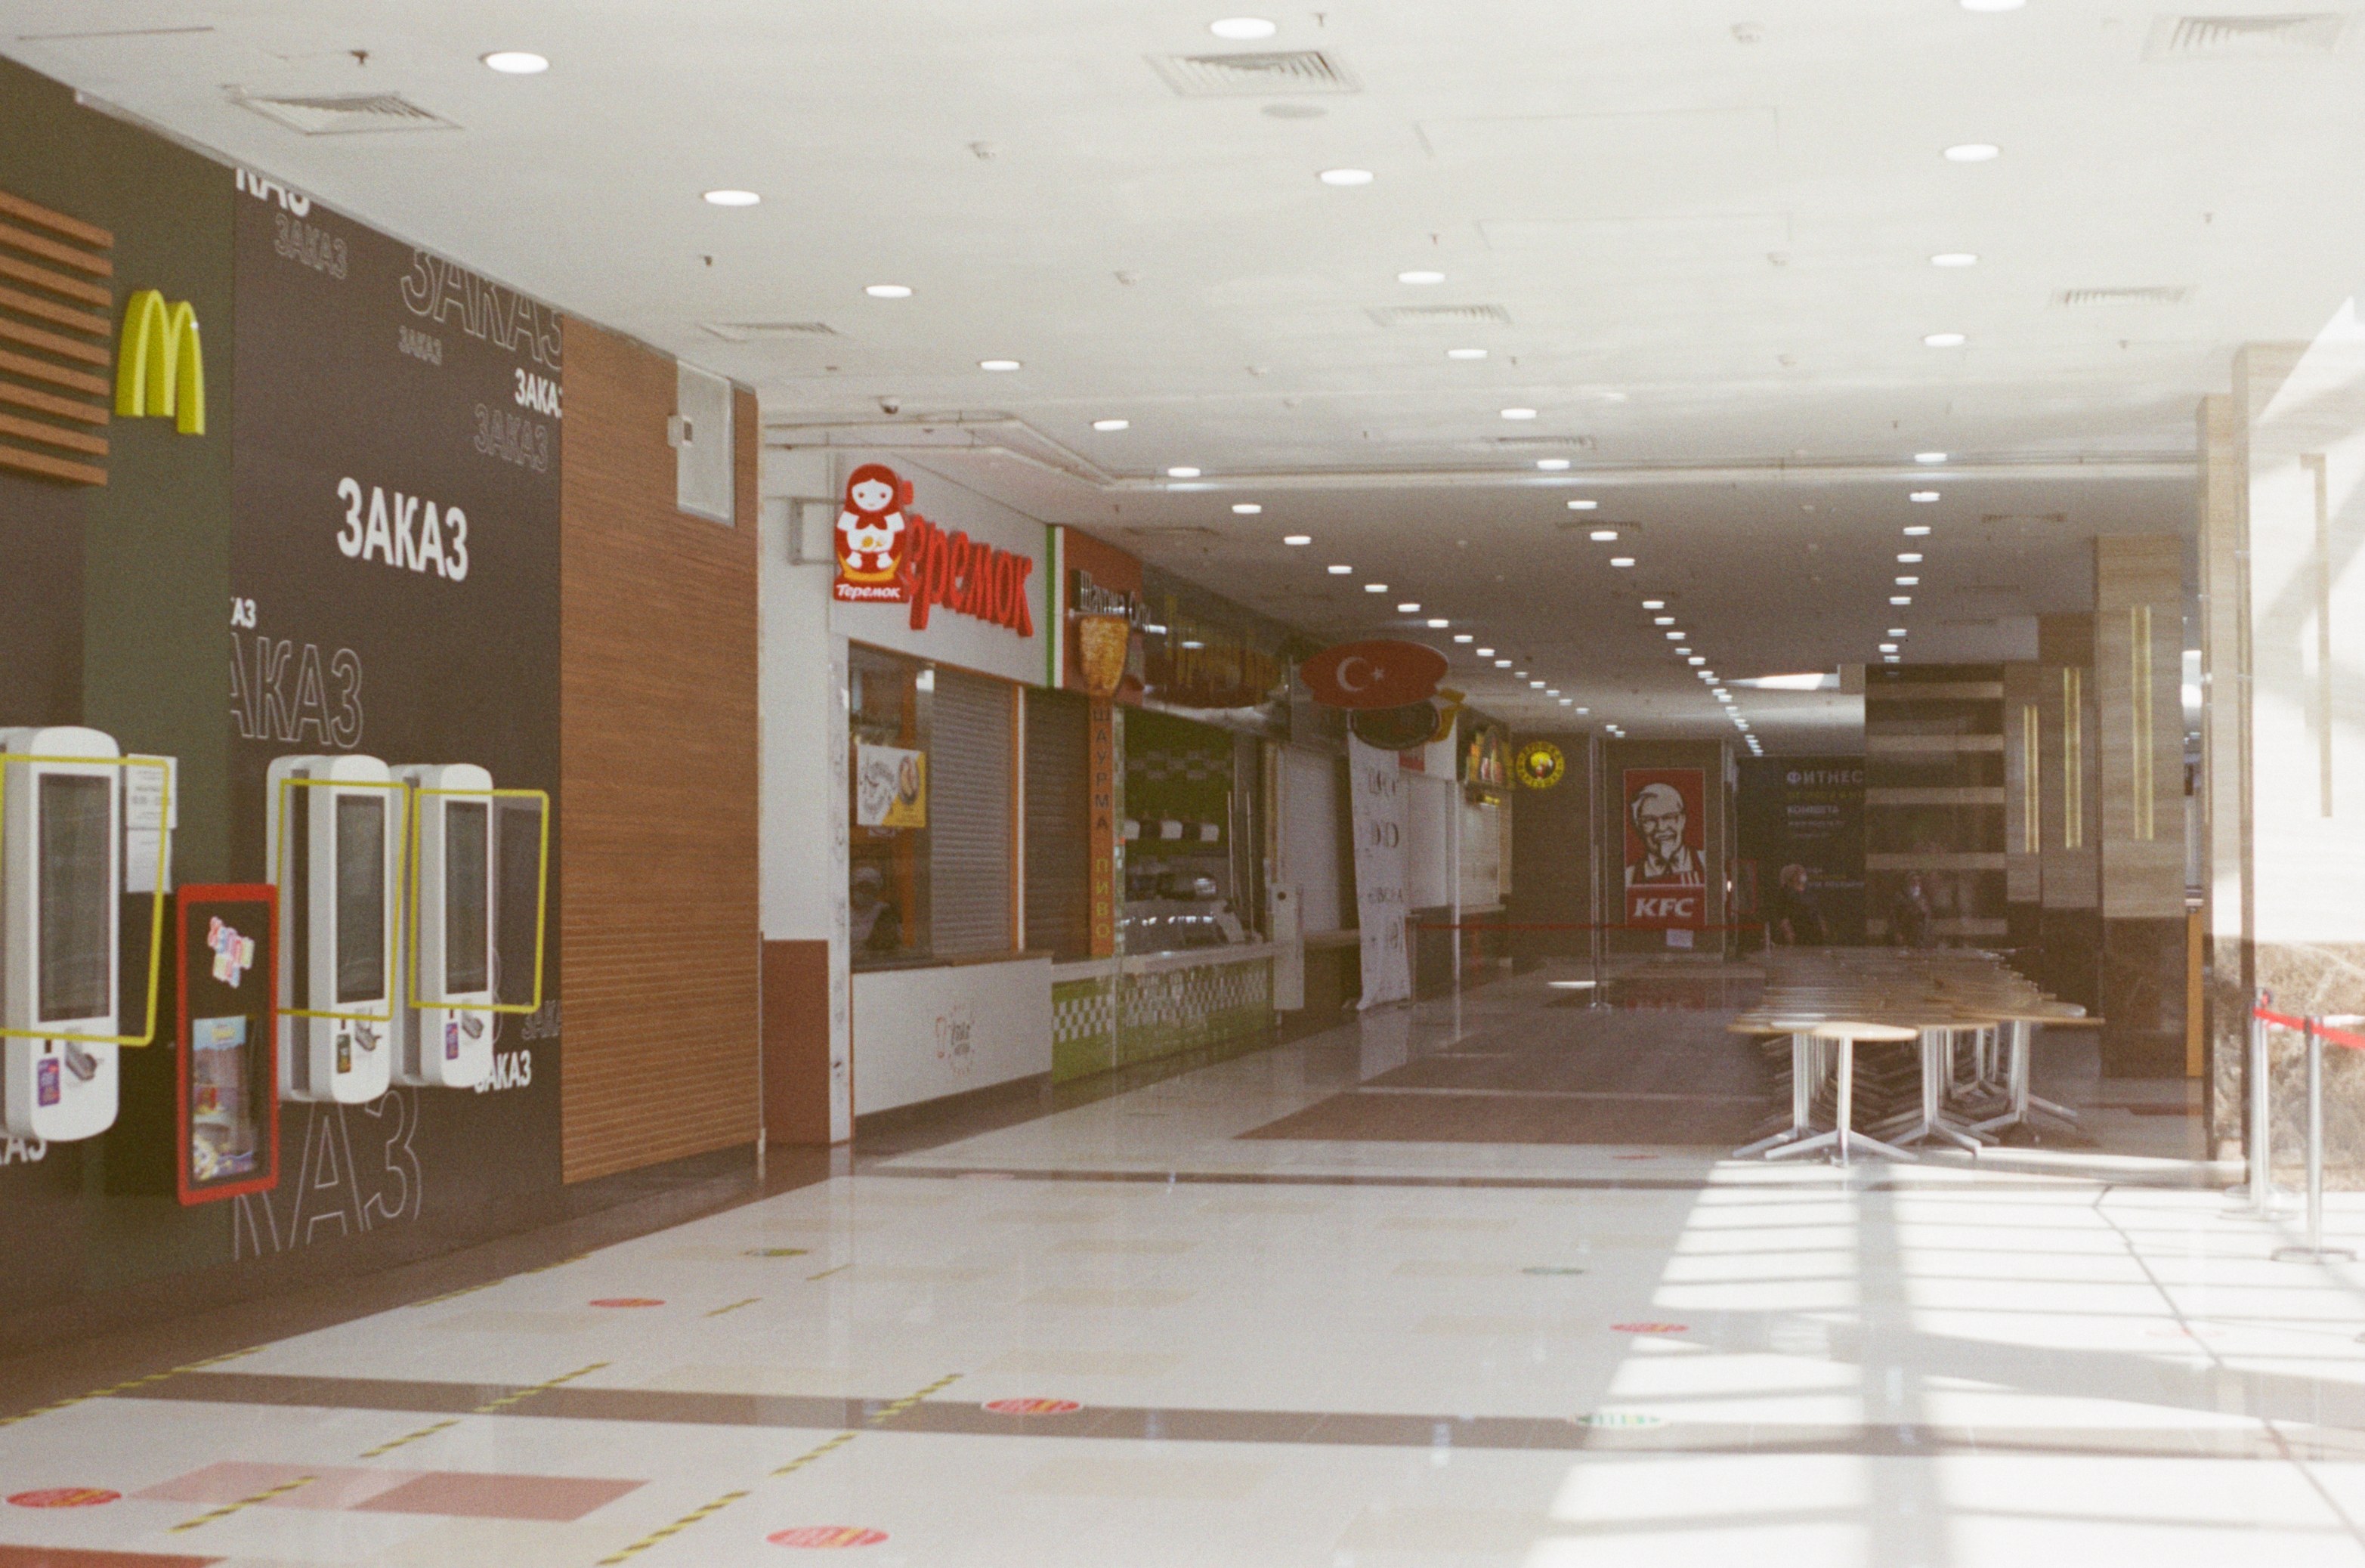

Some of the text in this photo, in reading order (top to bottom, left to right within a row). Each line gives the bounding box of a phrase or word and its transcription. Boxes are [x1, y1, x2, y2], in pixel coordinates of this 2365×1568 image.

[515, 367, 562, 419] ЗАКА
[337, 477, 468, 582] ЗАКАЗ
[904, 481, 1034, 636] еремок
[836, 583, 901, 599] Теремок
[230, 597, 257, 629] АЗ
[1634, 897, 1695, 917] KFC
